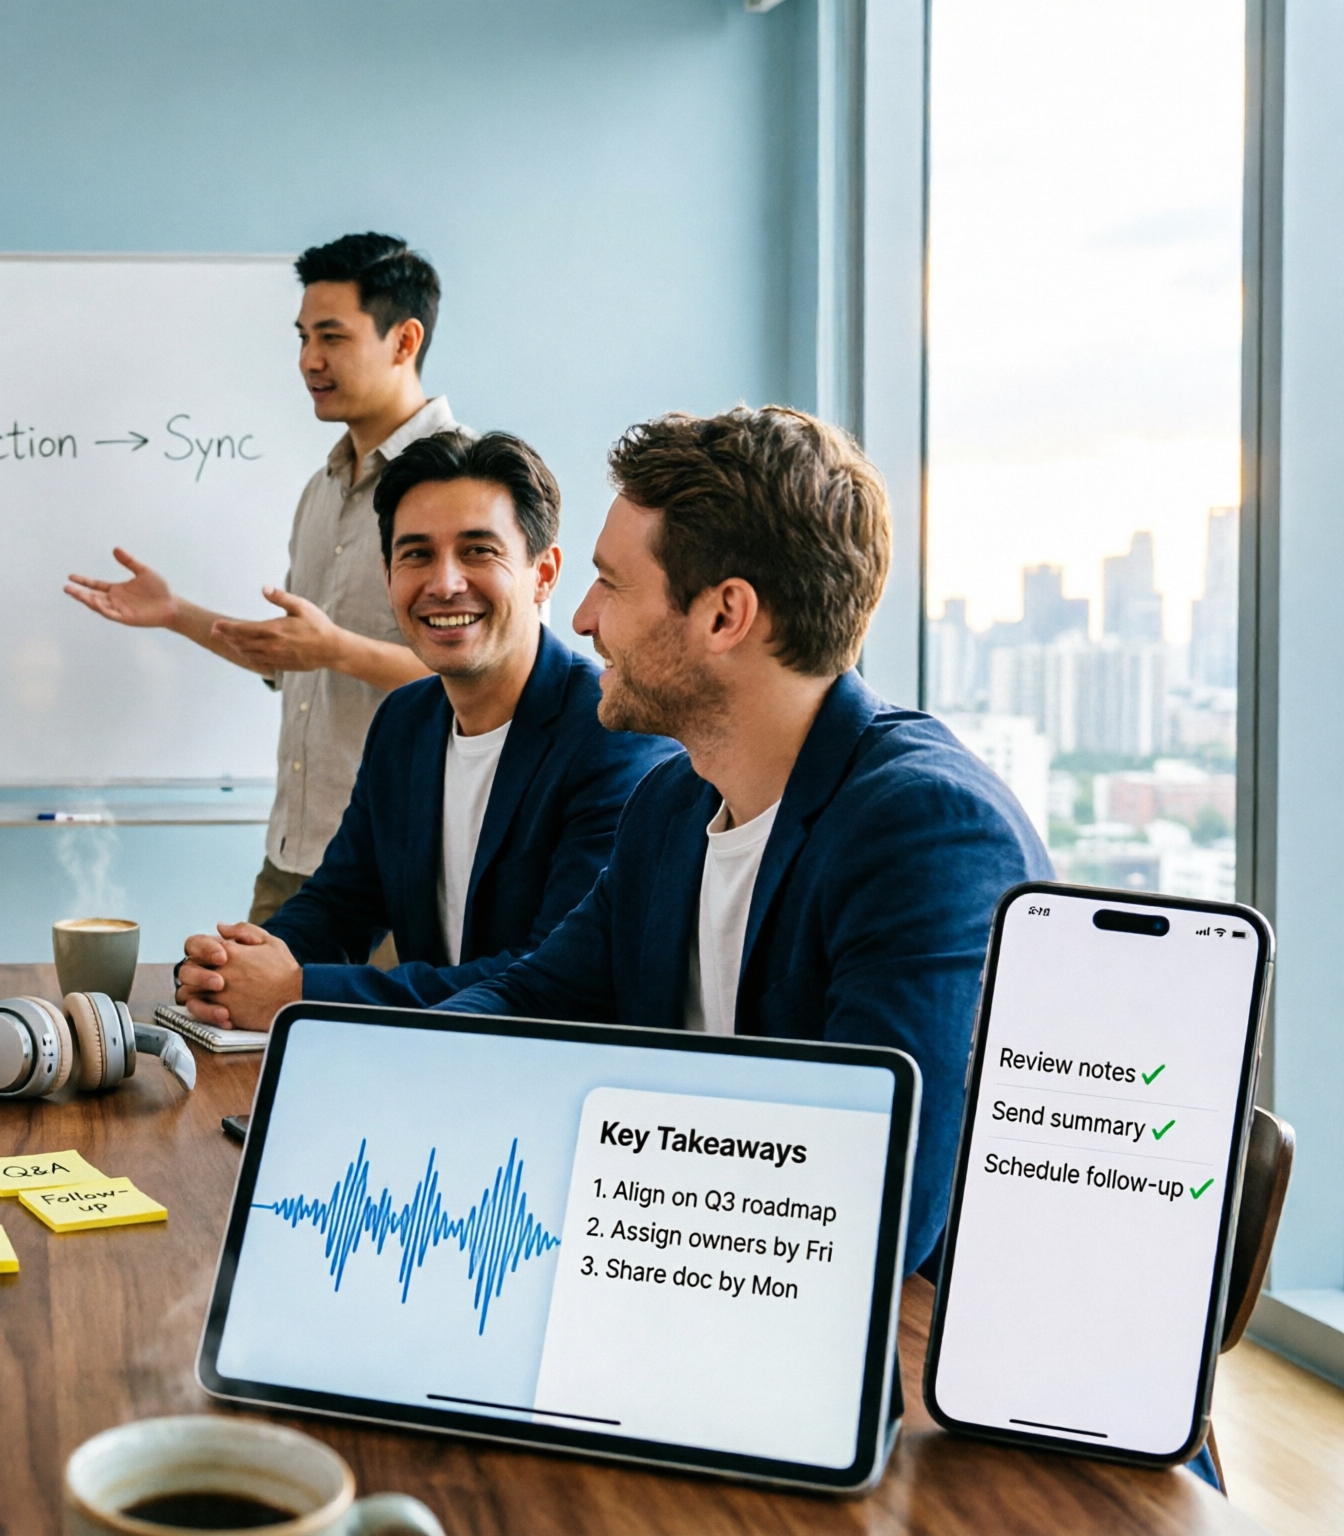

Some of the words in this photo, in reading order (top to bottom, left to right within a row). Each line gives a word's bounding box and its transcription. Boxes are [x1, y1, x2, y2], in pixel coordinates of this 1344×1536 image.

[163, 413, 260, 482] Sync
[999, 1047, 1073, 1074] Review
[1078, 1061, 1135, 1082] notes
[991, 1100, 1045, 1125] Send
[1049, 1112, 1146, 1142] summary
[600, 1120, 650, 1153] Key
[657, 1125, 806, 1168] Takeaways
[2, 1162, 70, 1177] Q&A
[984, 1153, 1079, 1184] Schedule
[1086, 1165, 1183, 1201] follow-up
[40, 1189, 129, 1206] Follow-
[78, 1202, 108, 1214] up
[593, 1178, 606, 1198] 1.
[612, 1180, 664, 1208] Align
[671, 1190, 697, 1207] on
[704, 1189, 735, 1211] Q3
[741, 1197, 836, 1226] roadmap
[586, 1216, 603, 1237] 2.
[610, 1219, 681, 1249] Assign
[688, 1232, 766, 1254] owners
[773, 1235, 800, 1263] by
[806, 1239, 833, 1262] Fri
[580, 1255, 598, 1276] 3.
[605, 1258, 666, 1283] Share
[672, 1265, 712, 1289] doc
[718, 1270, 745, 1297] by
[751, 1274, 797, 1299] Mon
